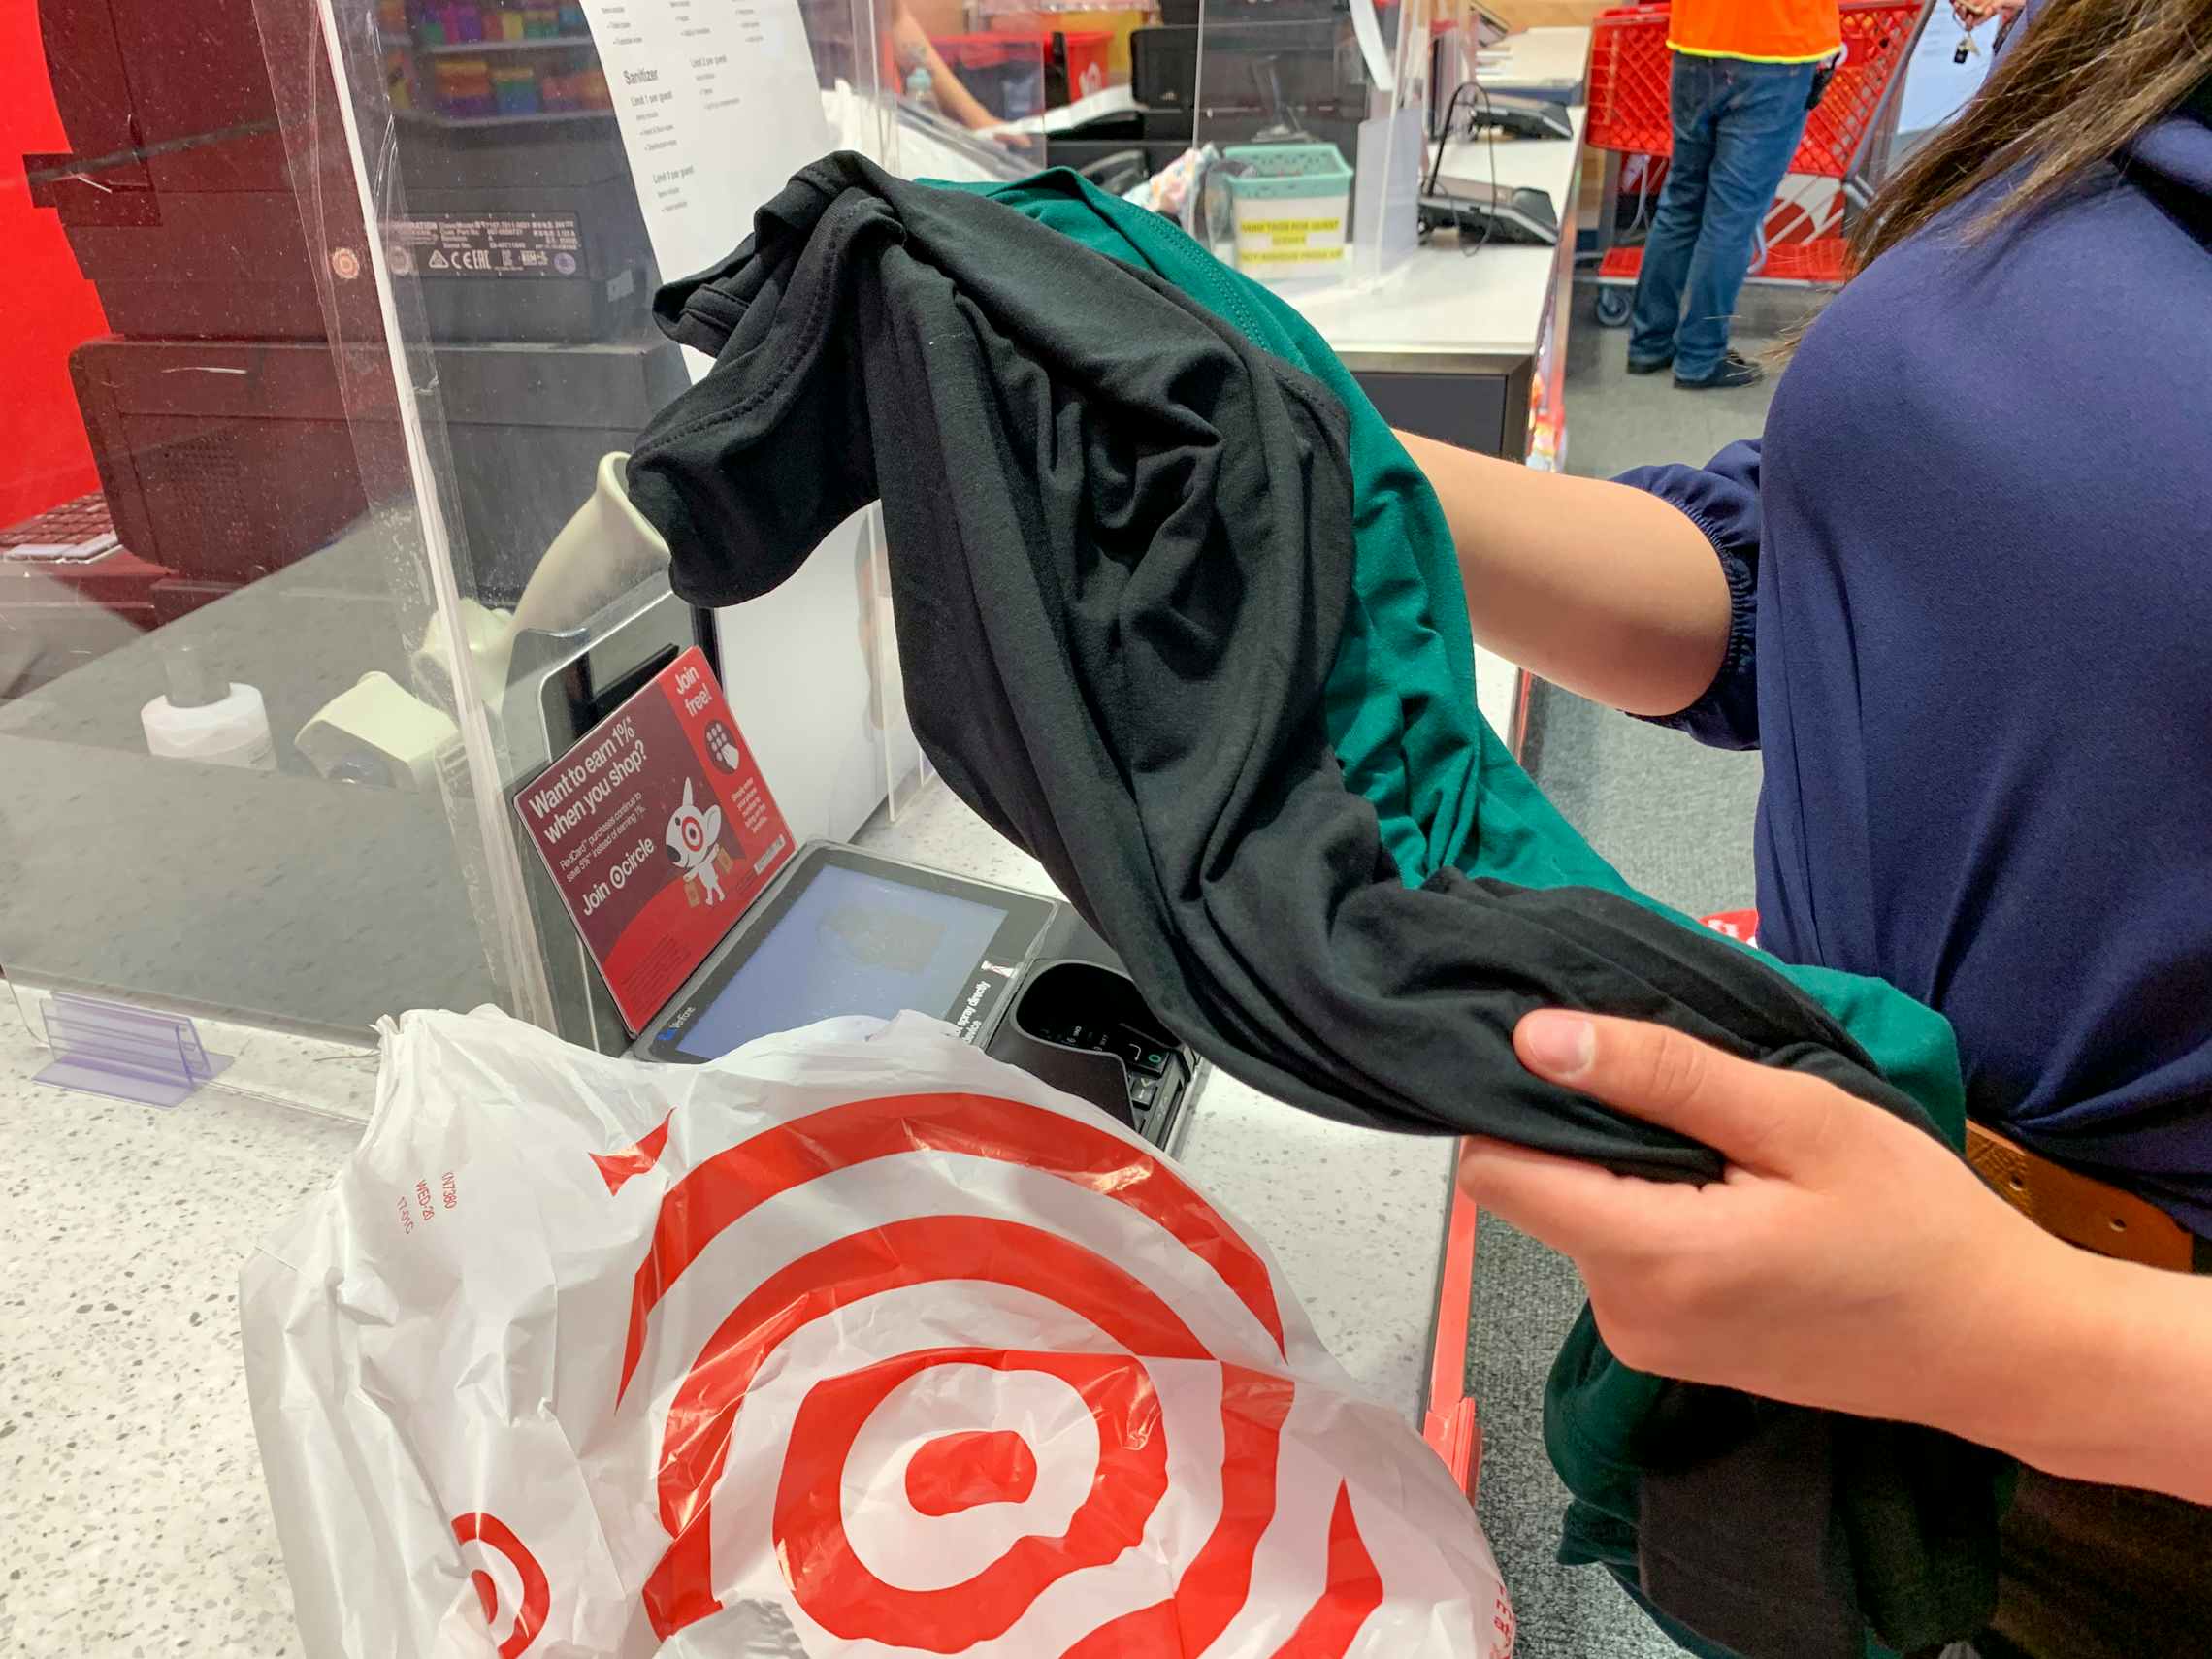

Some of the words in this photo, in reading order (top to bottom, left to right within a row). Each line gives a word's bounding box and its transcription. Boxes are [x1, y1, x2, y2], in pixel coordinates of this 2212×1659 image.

[623, 66, 659, 86] Sanitizer
[674, 666, 699, 695] Join
[684, 682, 713, 717] free!
[528, 773, 574, 820] Want
[567, 764, 587, 787] to
[584, 738, 617, 774] earn
[543, 800, 587, 844] when
[582, 777, 612, 815] you
[608, 738, 648, 787] shop?
[592, 834, 613, 858] instead
[610, 827, 619, 840] of
[582, 881, 611, 916] Join
[621, 837, 655, 876] circle
[957, 1005, 976, 1026] spray
[967, 980, 991, 1007] directly
[961, 1020, 982, 1044] device
